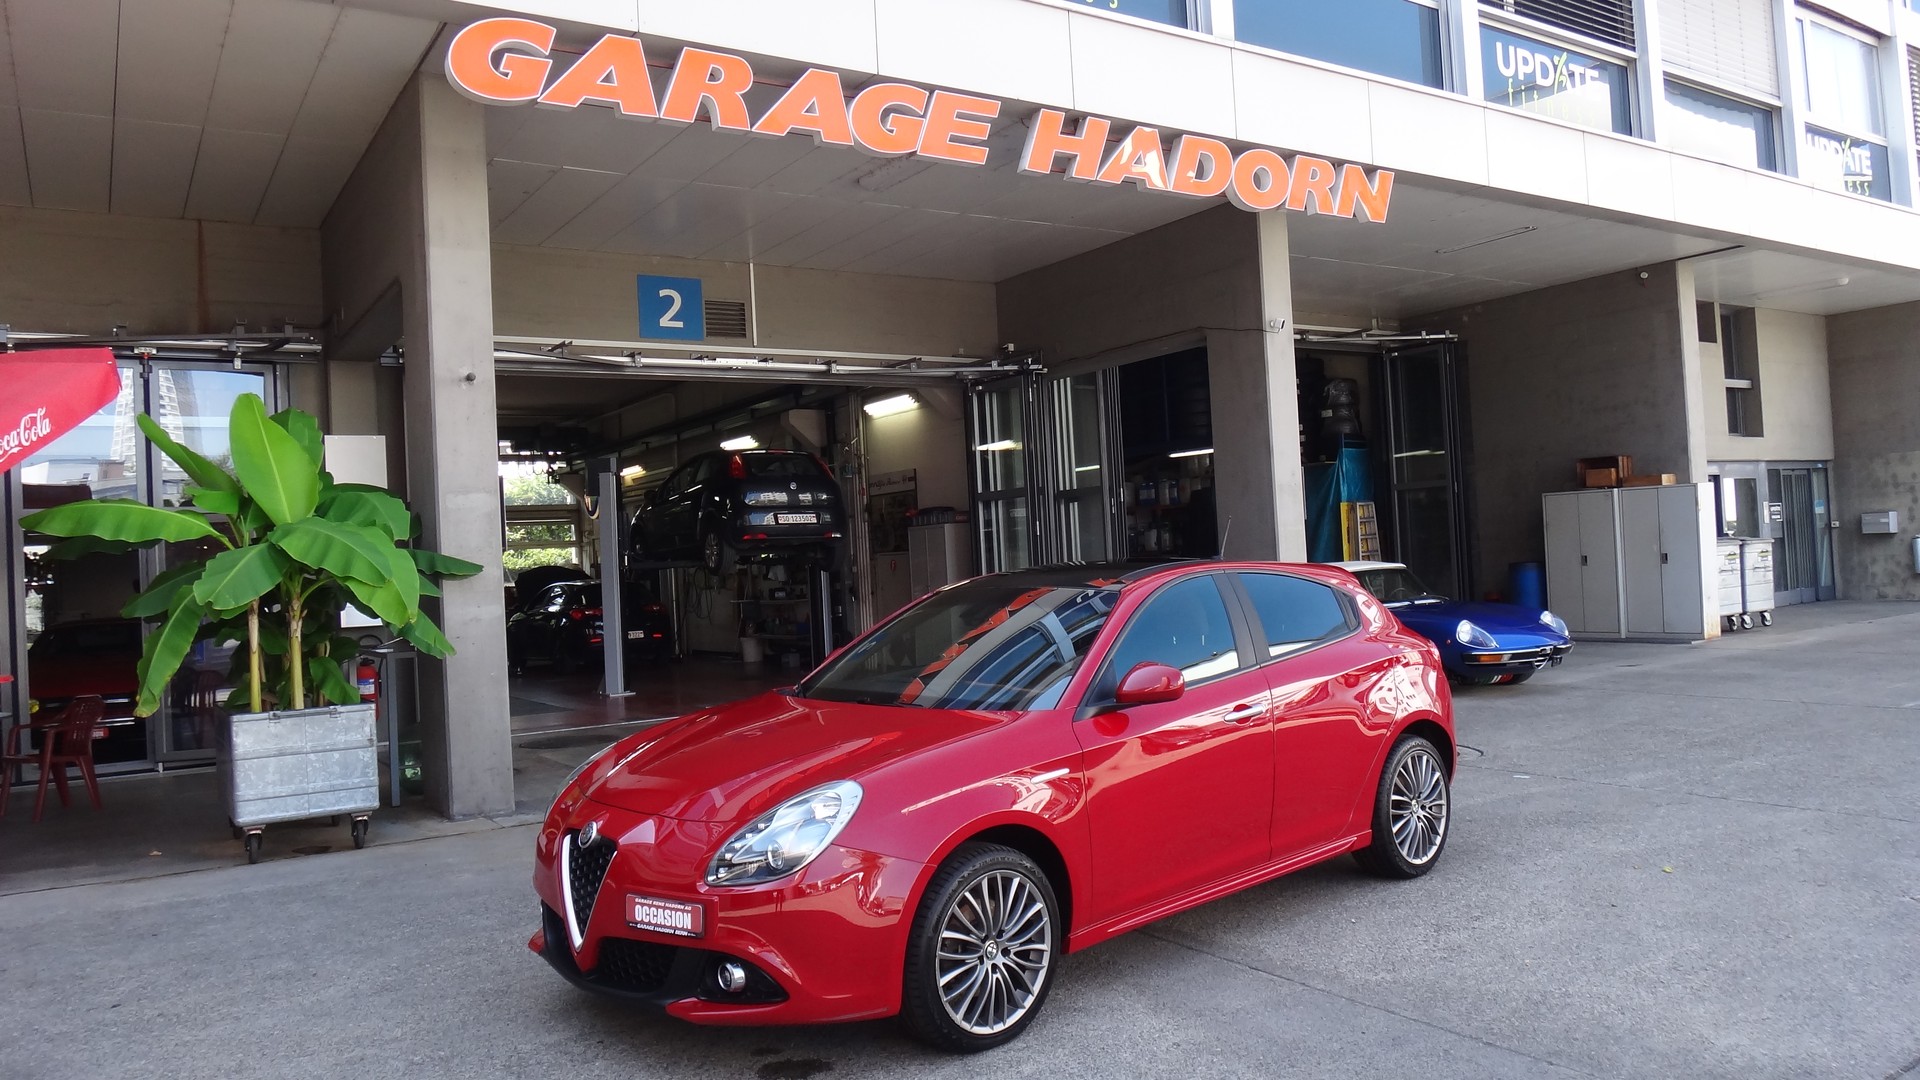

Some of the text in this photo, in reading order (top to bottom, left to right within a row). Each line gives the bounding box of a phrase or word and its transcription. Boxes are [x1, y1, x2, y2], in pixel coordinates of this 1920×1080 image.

[1495, 41, 1600, 96] UPDATE
[446, 17, 1395, 224] GARAGE HADORN
[658, 288, 684, 328] 2
[0, 406, 52, 463] oca-Cola
[635, 904, 691, 929] OCCASION
